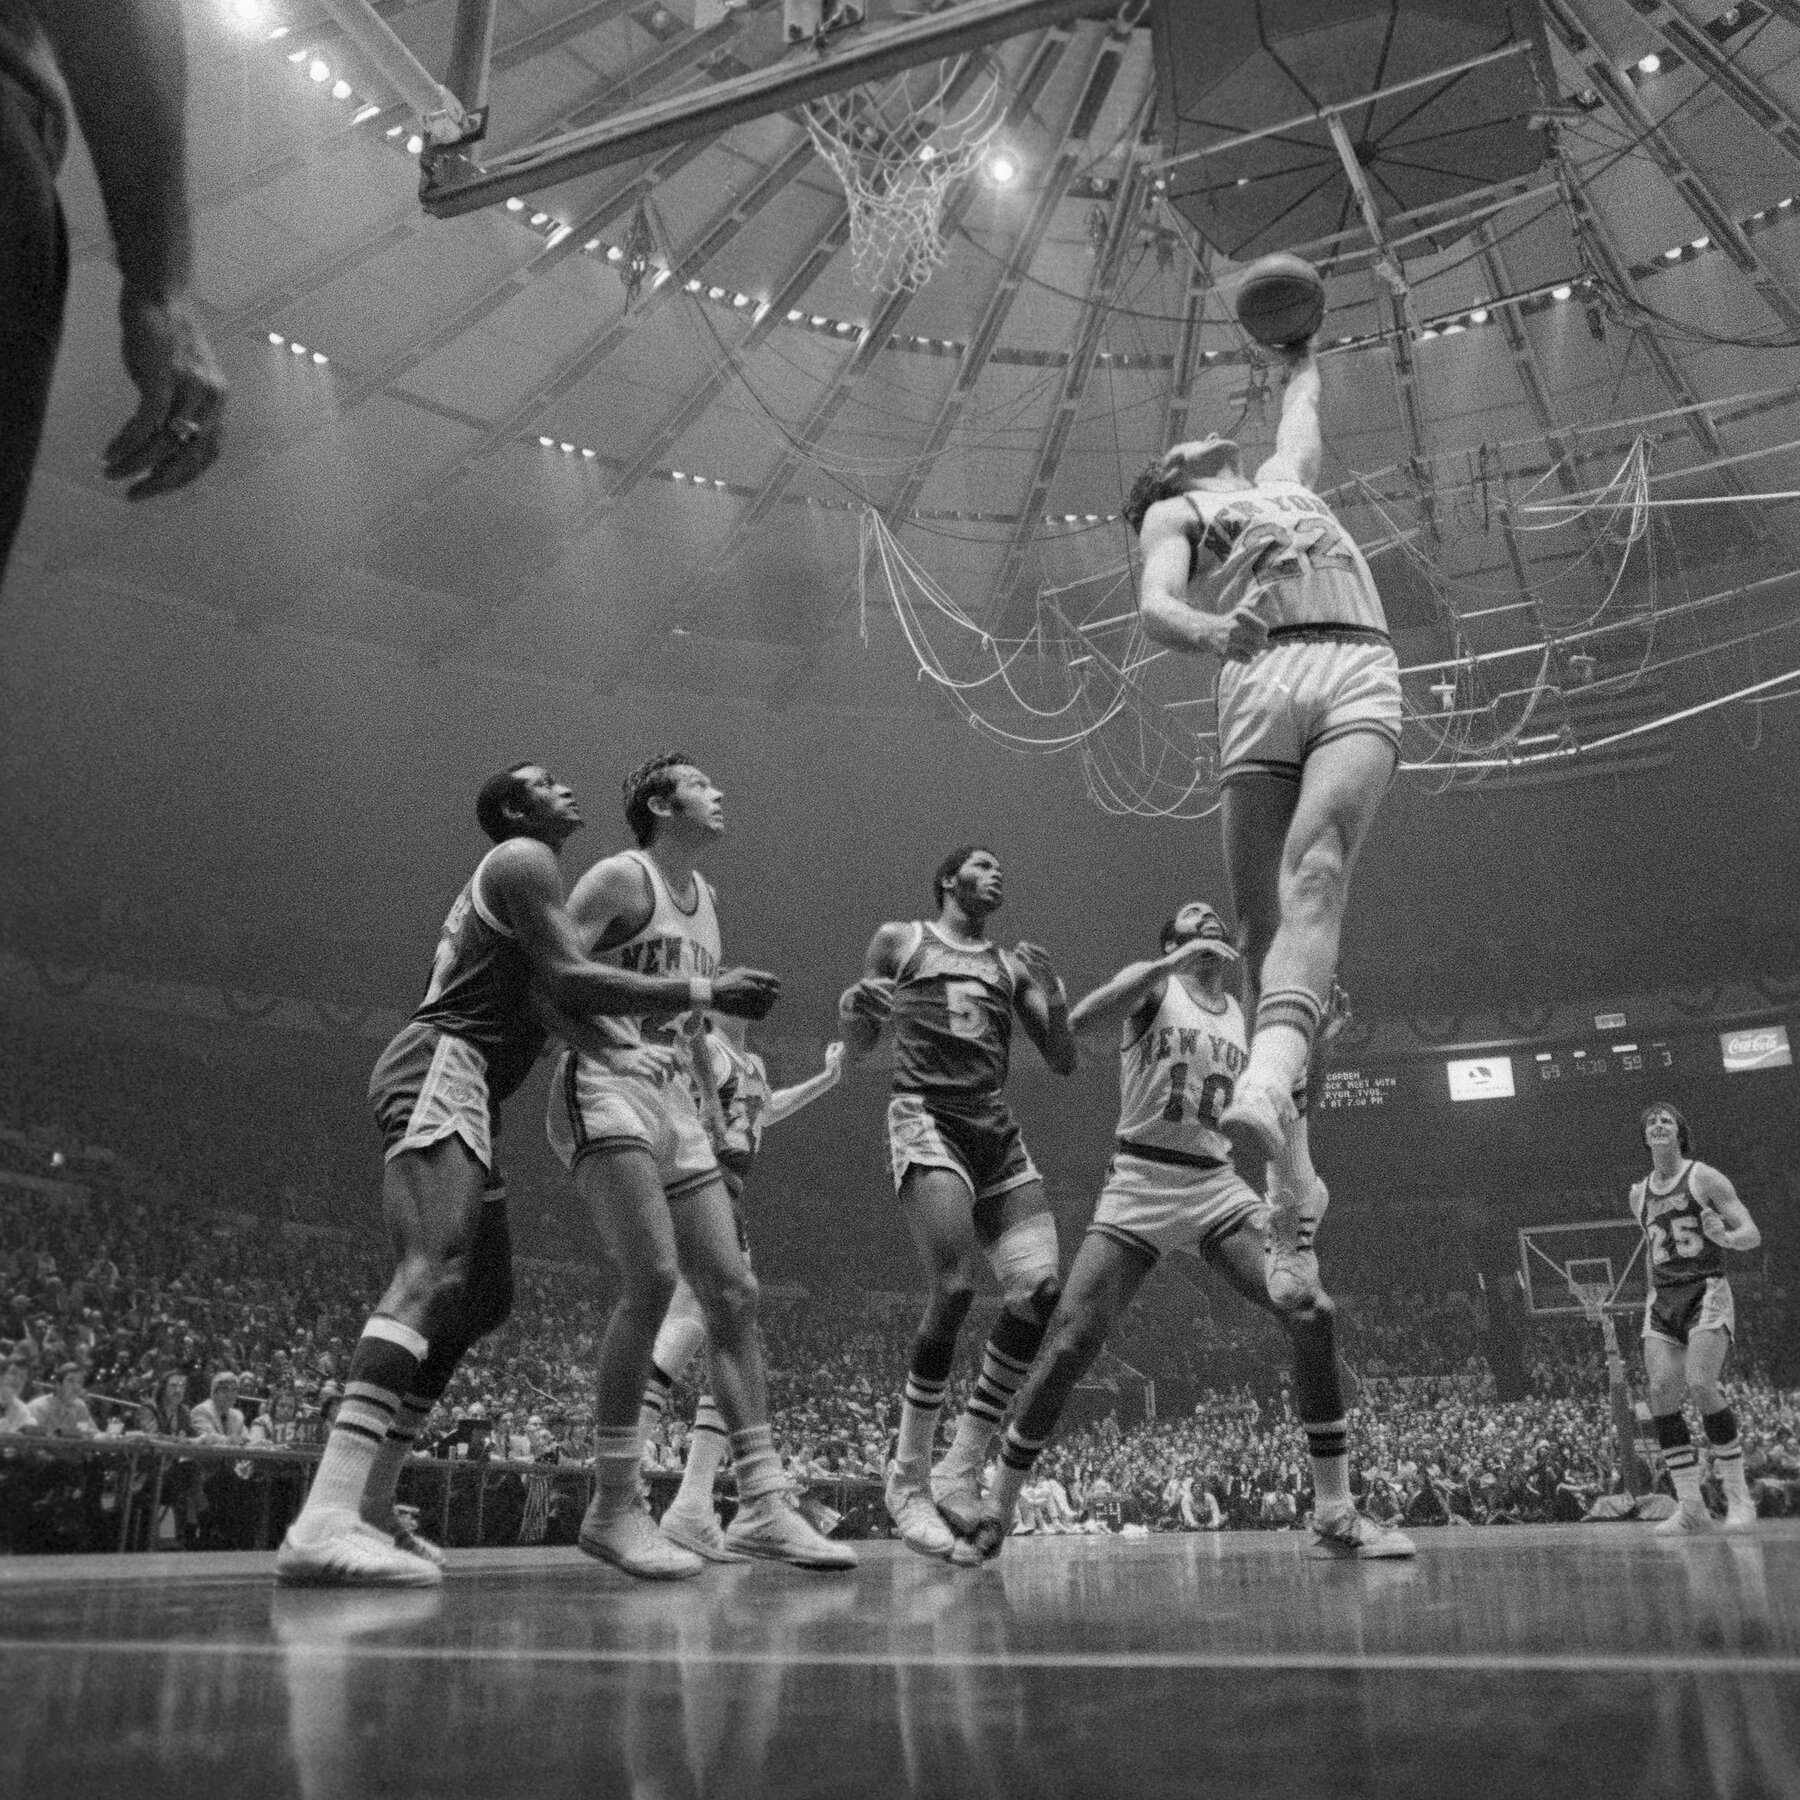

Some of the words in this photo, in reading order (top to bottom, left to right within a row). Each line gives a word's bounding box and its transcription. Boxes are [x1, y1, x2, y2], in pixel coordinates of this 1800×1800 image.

[1241, 516, 1352, 586] 22
[621, 937, 682, 976] NEW
[946, 982, 990, 1040] 5
[1138, 1026, 1201, 1076] NEW
[1207, 1033, 1250, 1077] YOR
[1163, 1062, 1235, 1131] 10
[1647, 1215, 1704, 1266] 25
